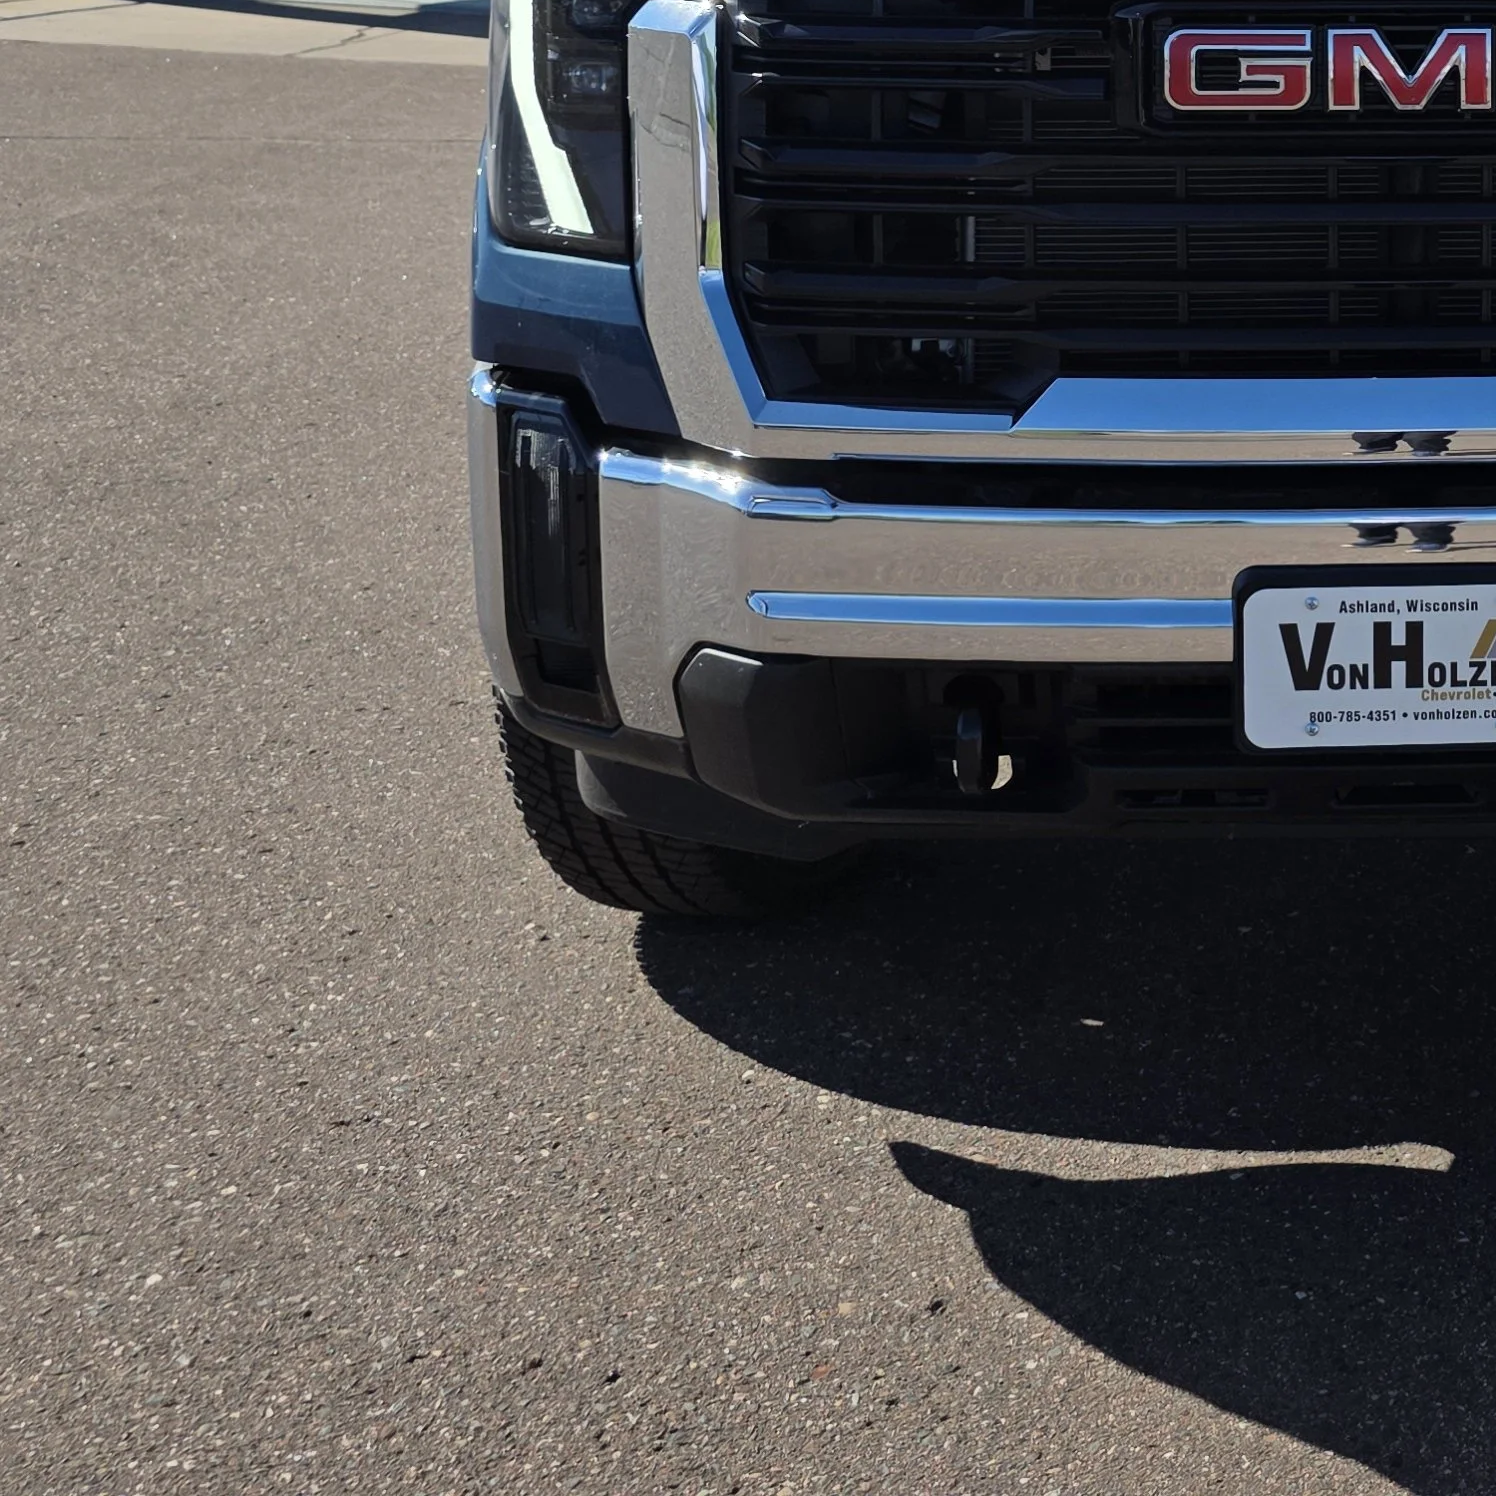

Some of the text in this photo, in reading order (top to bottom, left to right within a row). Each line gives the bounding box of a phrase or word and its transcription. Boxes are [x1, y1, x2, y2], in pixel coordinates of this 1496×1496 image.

[1339, 598, 1479, 614] Ashland, Wisconsin
[1309, 710, 1397, 723] 800-785-4351
